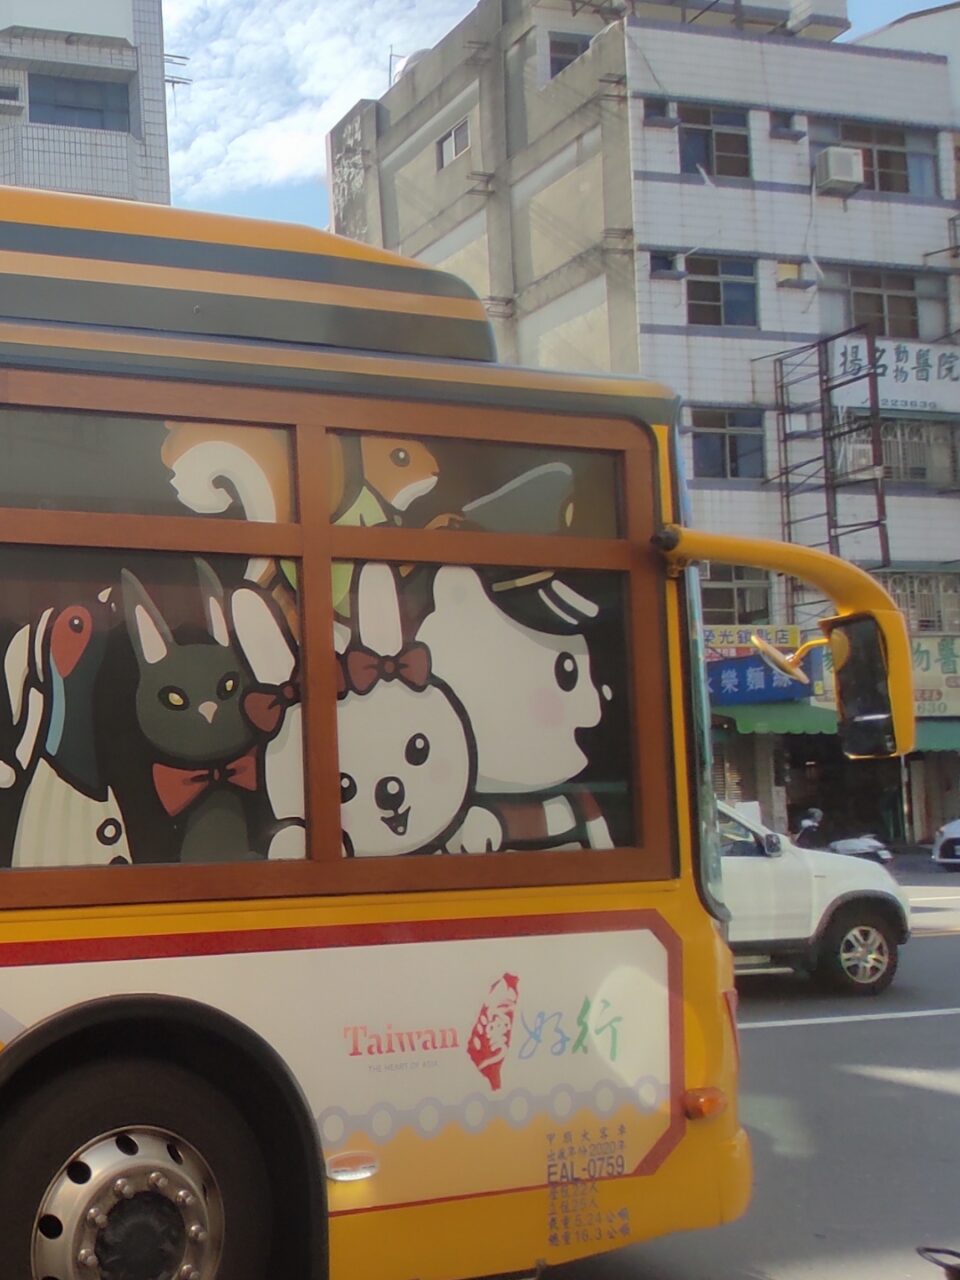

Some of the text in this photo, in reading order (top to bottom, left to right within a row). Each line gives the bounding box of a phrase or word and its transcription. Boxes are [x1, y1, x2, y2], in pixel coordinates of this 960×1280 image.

[343, 1023, 460, 1056] Taiwan
[518, 996, 624, 1062] 好行
[547, 1154, 624, 1184] EAL-0759
